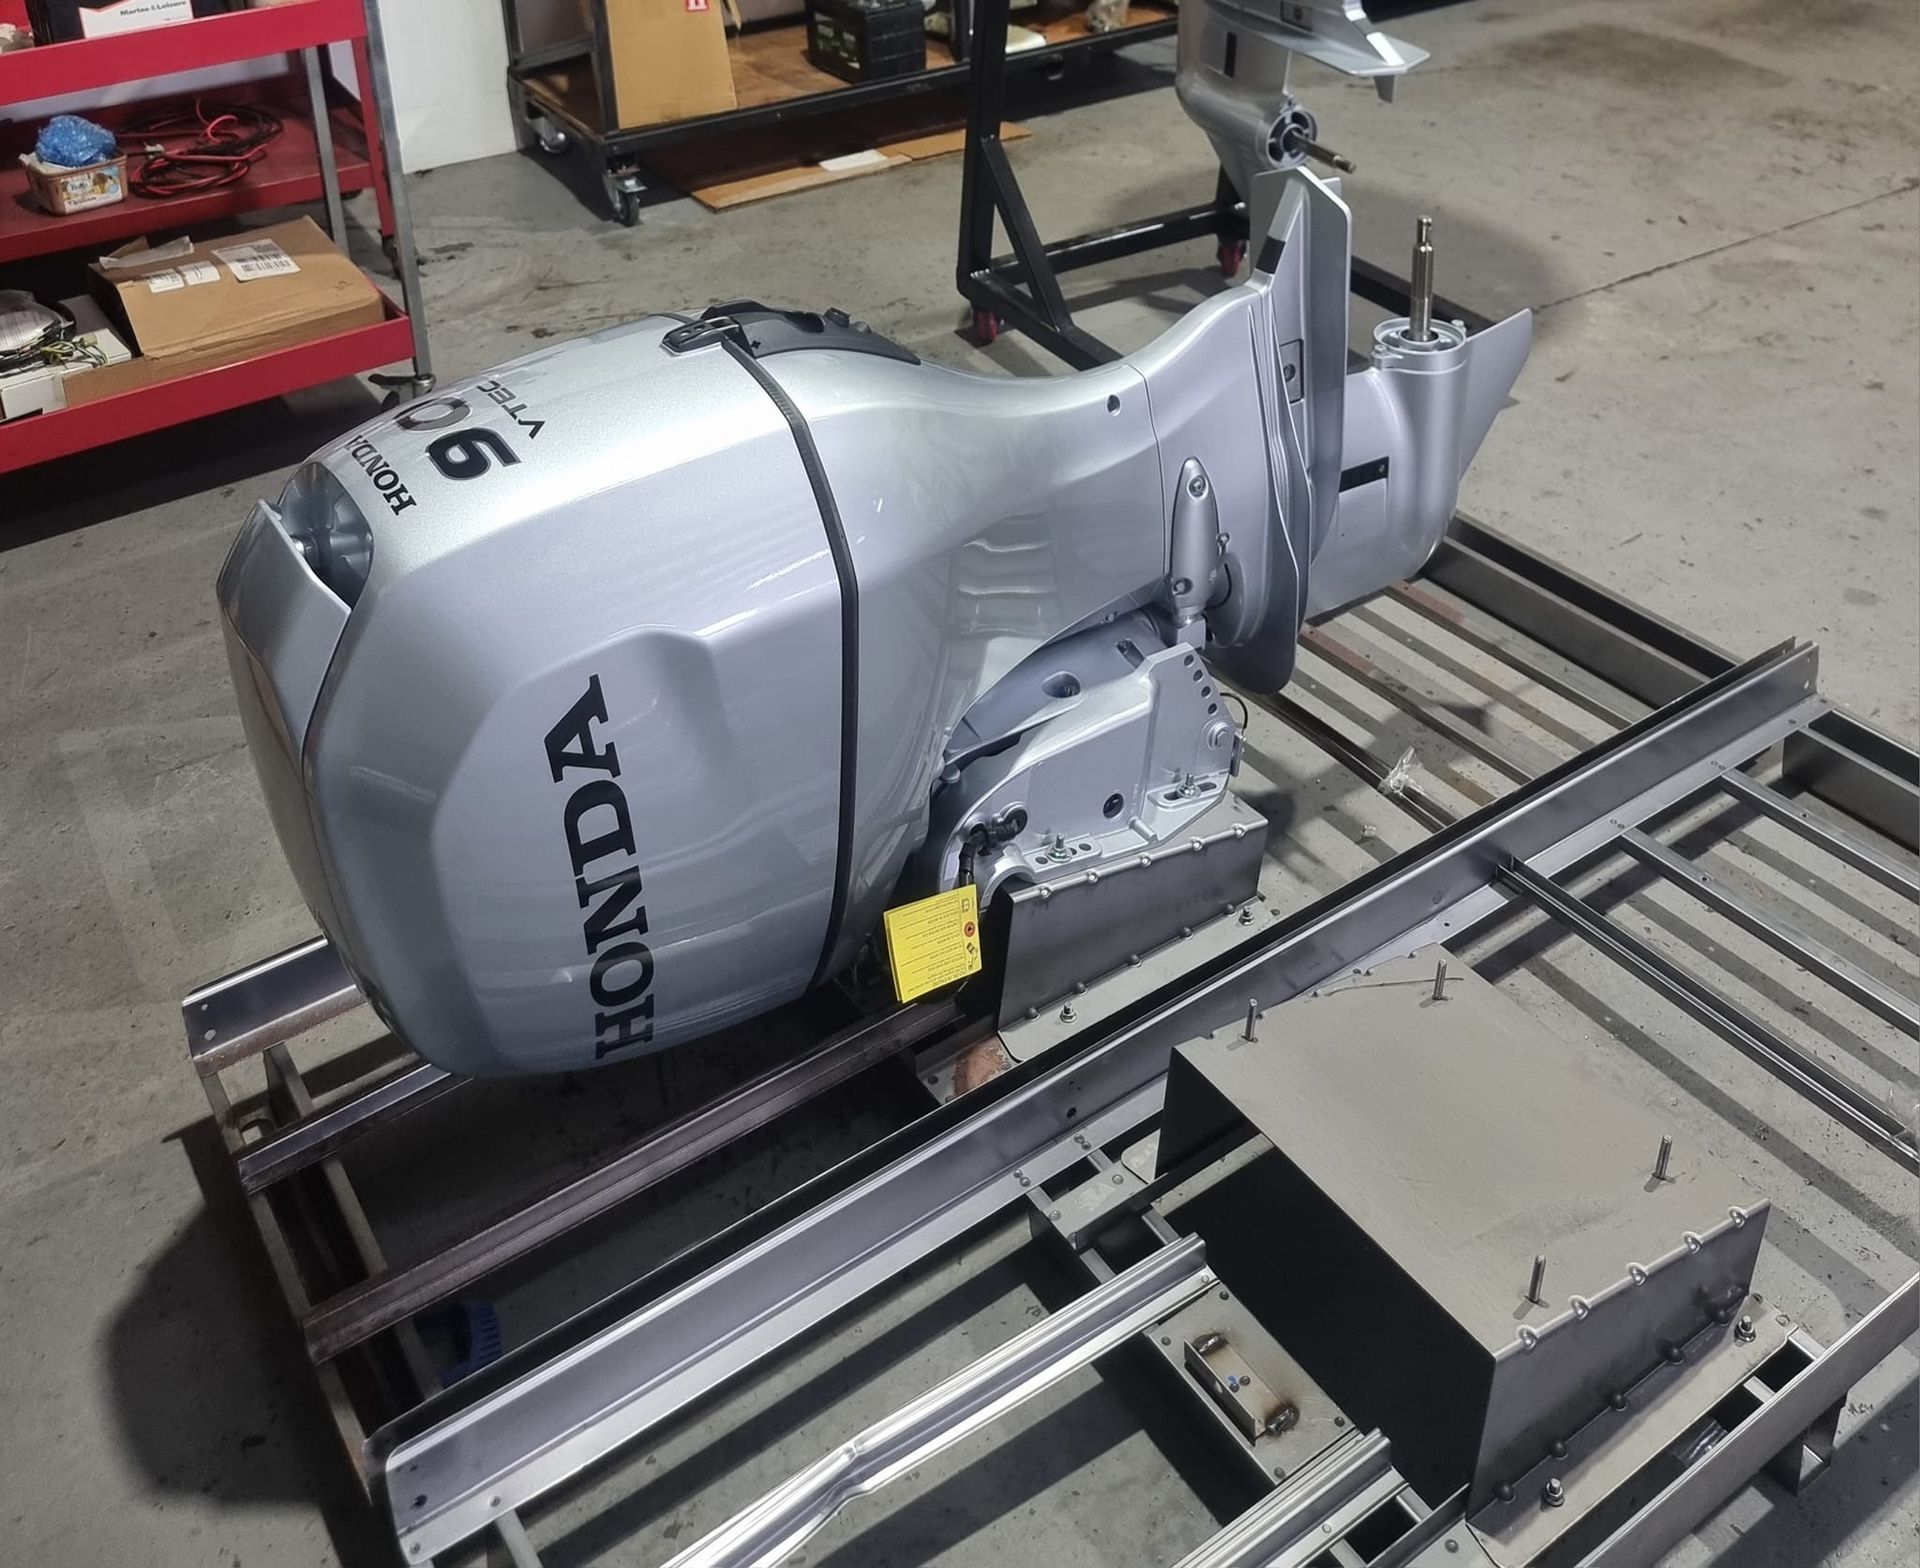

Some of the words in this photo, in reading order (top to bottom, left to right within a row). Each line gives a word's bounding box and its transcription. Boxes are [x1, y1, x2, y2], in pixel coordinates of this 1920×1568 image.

[119, 6, 150, 17] Marine
[156, 0, 187, 10] Leisure
[393, 397, 521, 480] 90
[476, 380, 546, 439] VTEC
[344, 435, 417, 515] HONDA
[544, 674, 656, 1060] HONDA
